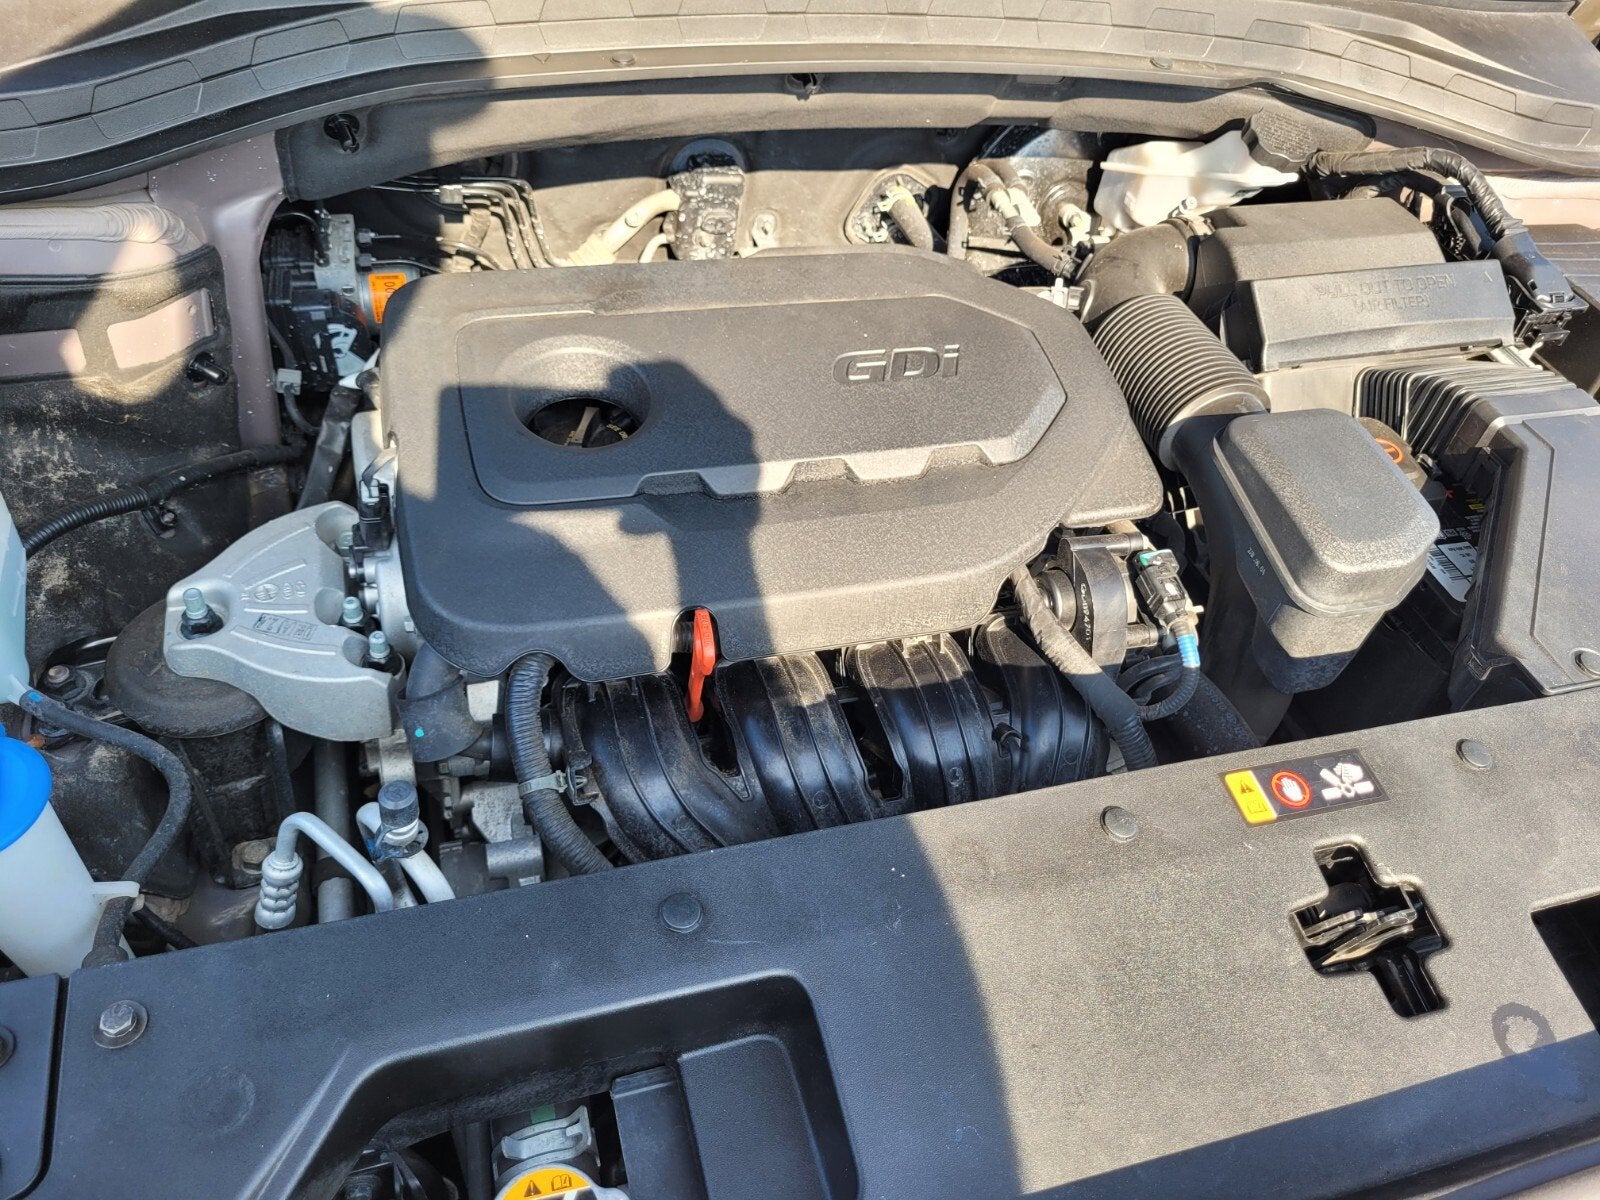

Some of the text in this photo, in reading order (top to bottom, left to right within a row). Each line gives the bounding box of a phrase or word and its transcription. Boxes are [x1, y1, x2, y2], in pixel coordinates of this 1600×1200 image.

[1314, 273, 1457, 299] PULL OUT TO OPEN
[832, 344, 960, 382] GDi
